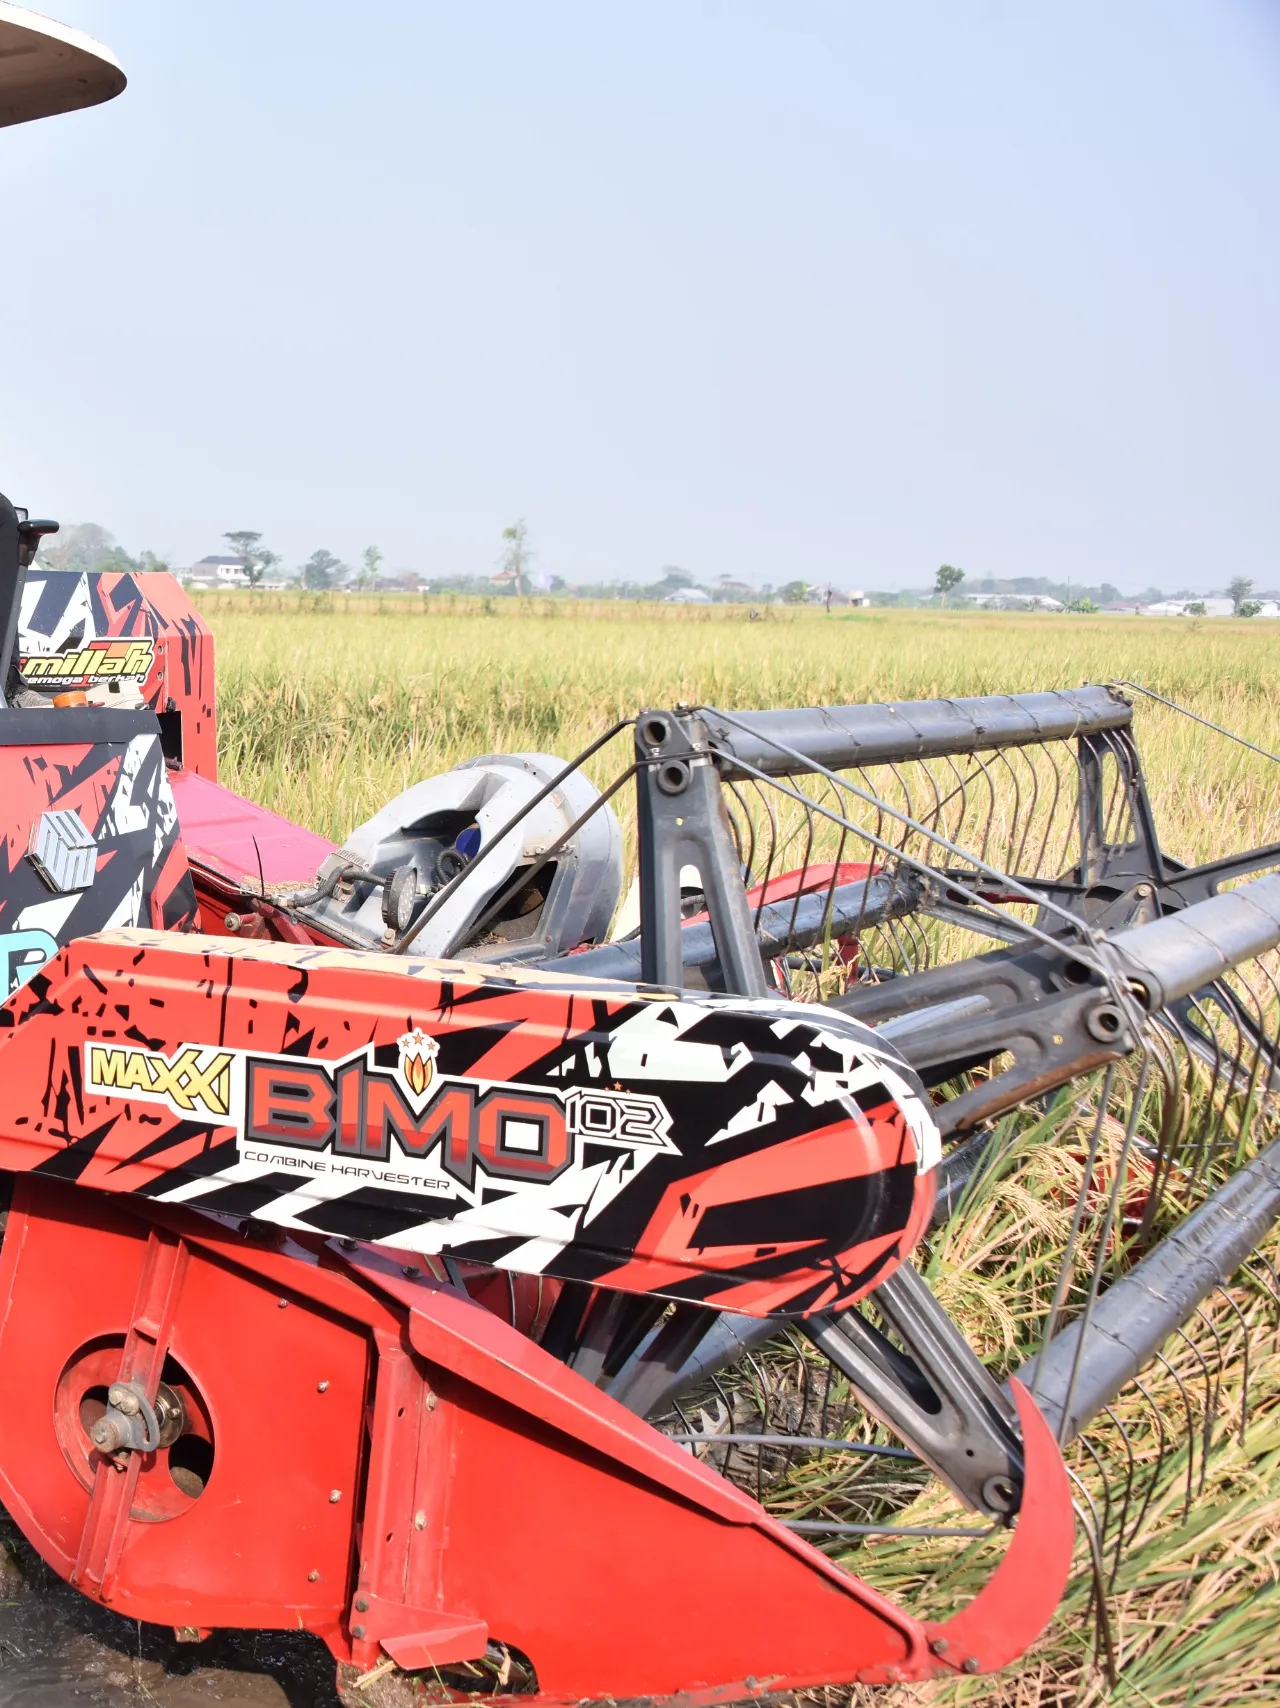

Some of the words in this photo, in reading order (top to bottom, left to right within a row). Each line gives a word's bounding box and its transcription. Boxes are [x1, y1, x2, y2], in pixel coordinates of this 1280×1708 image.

[26, 675, 83, 686] emoga
[91, 1047, 237, 1116] MAXXI
[246, 1054, 577, 1187] BIMO
[565, 1088, 669, 1148] 102
[243, 1150, 327, 1172] COMBINE
[331, 1163, 451, 1191] HARVESTER
